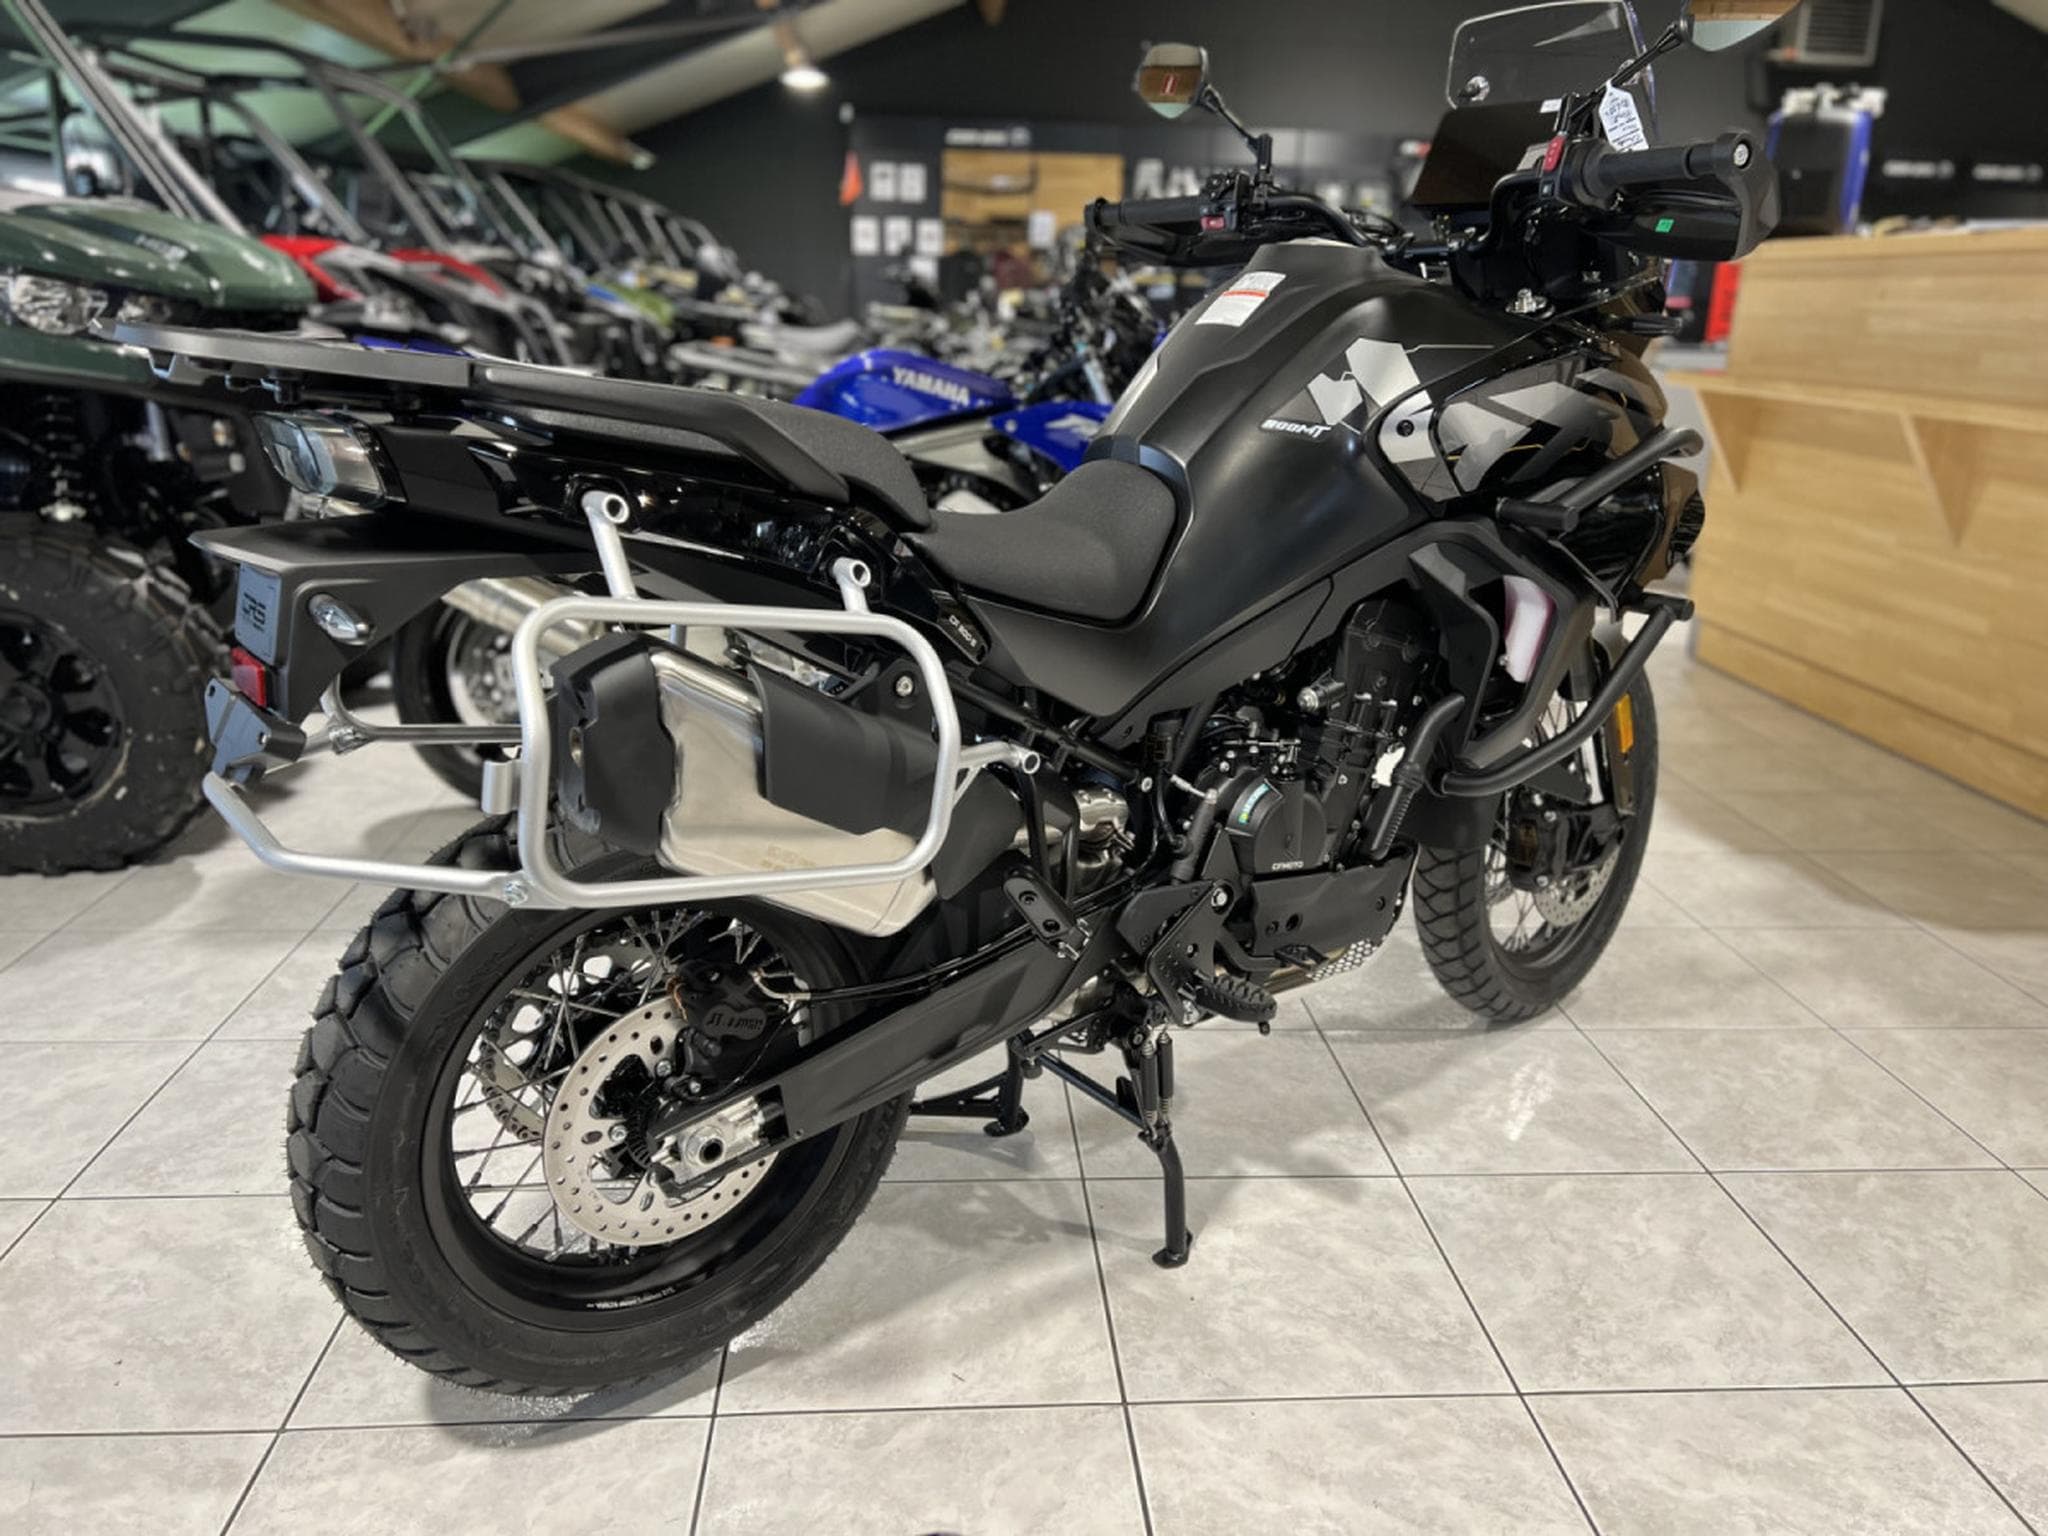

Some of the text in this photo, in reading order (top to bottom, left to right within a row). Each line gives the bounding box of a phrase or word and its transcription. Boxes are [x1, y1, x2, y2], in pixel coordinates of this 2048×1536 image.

[893, 366, 970, 407] YAMAHA
[1261, 419, 1332, 438] 800MT
[1271, 860, 1304, 871] CFMOTO
